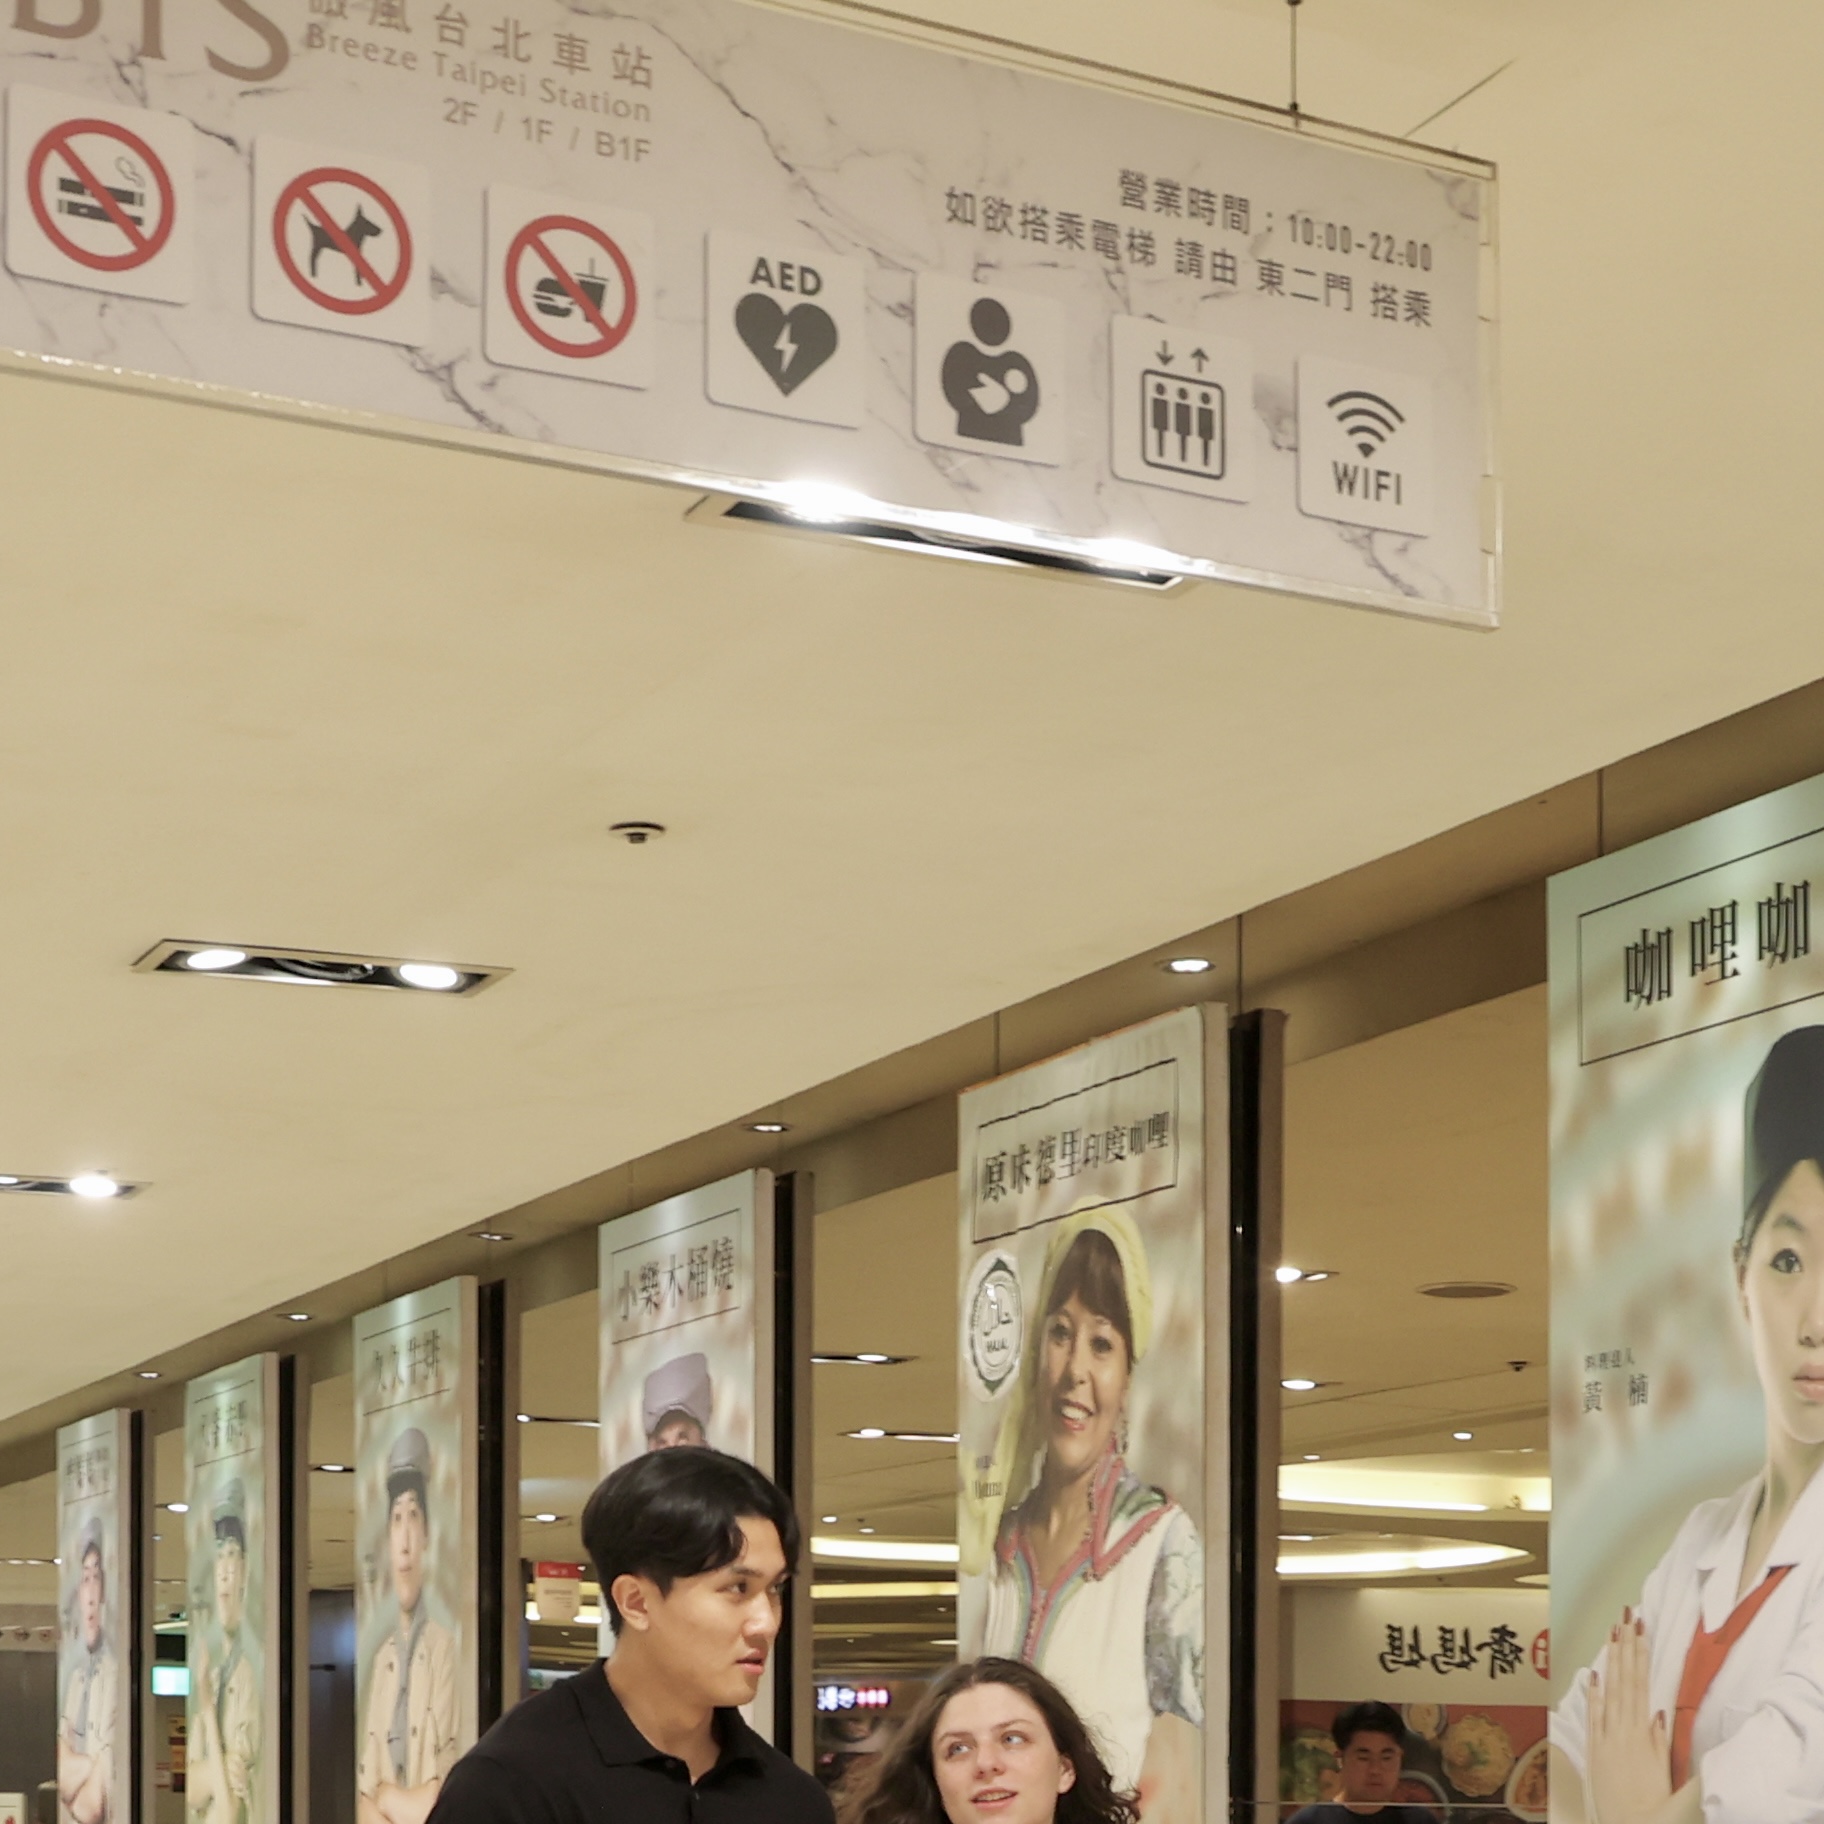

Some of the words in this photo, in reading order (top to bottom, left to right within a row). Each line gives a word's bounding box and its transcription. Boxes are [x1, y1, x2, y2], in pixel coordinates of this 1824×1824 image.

[306, 23, 418, 71] Breeze
[433, 49, 527, 98] Taipei
[538, 77, 652, 123] Station
[442, 96, 477, 126] 2F
[520, 115, 553, 145] 1F
[594, 131, 651, 164] B1F
[749, 256, 823, 297] AED
[944, 185, 1157, 268] 如欲搭乘電梯
[1174, 239, 1238, 287] 請由
[1255, 257, 1353, 314] 東二門
[1370, 282, 1433, 328] 搭乘
[1332, 459, 1403, 505] WIFI
